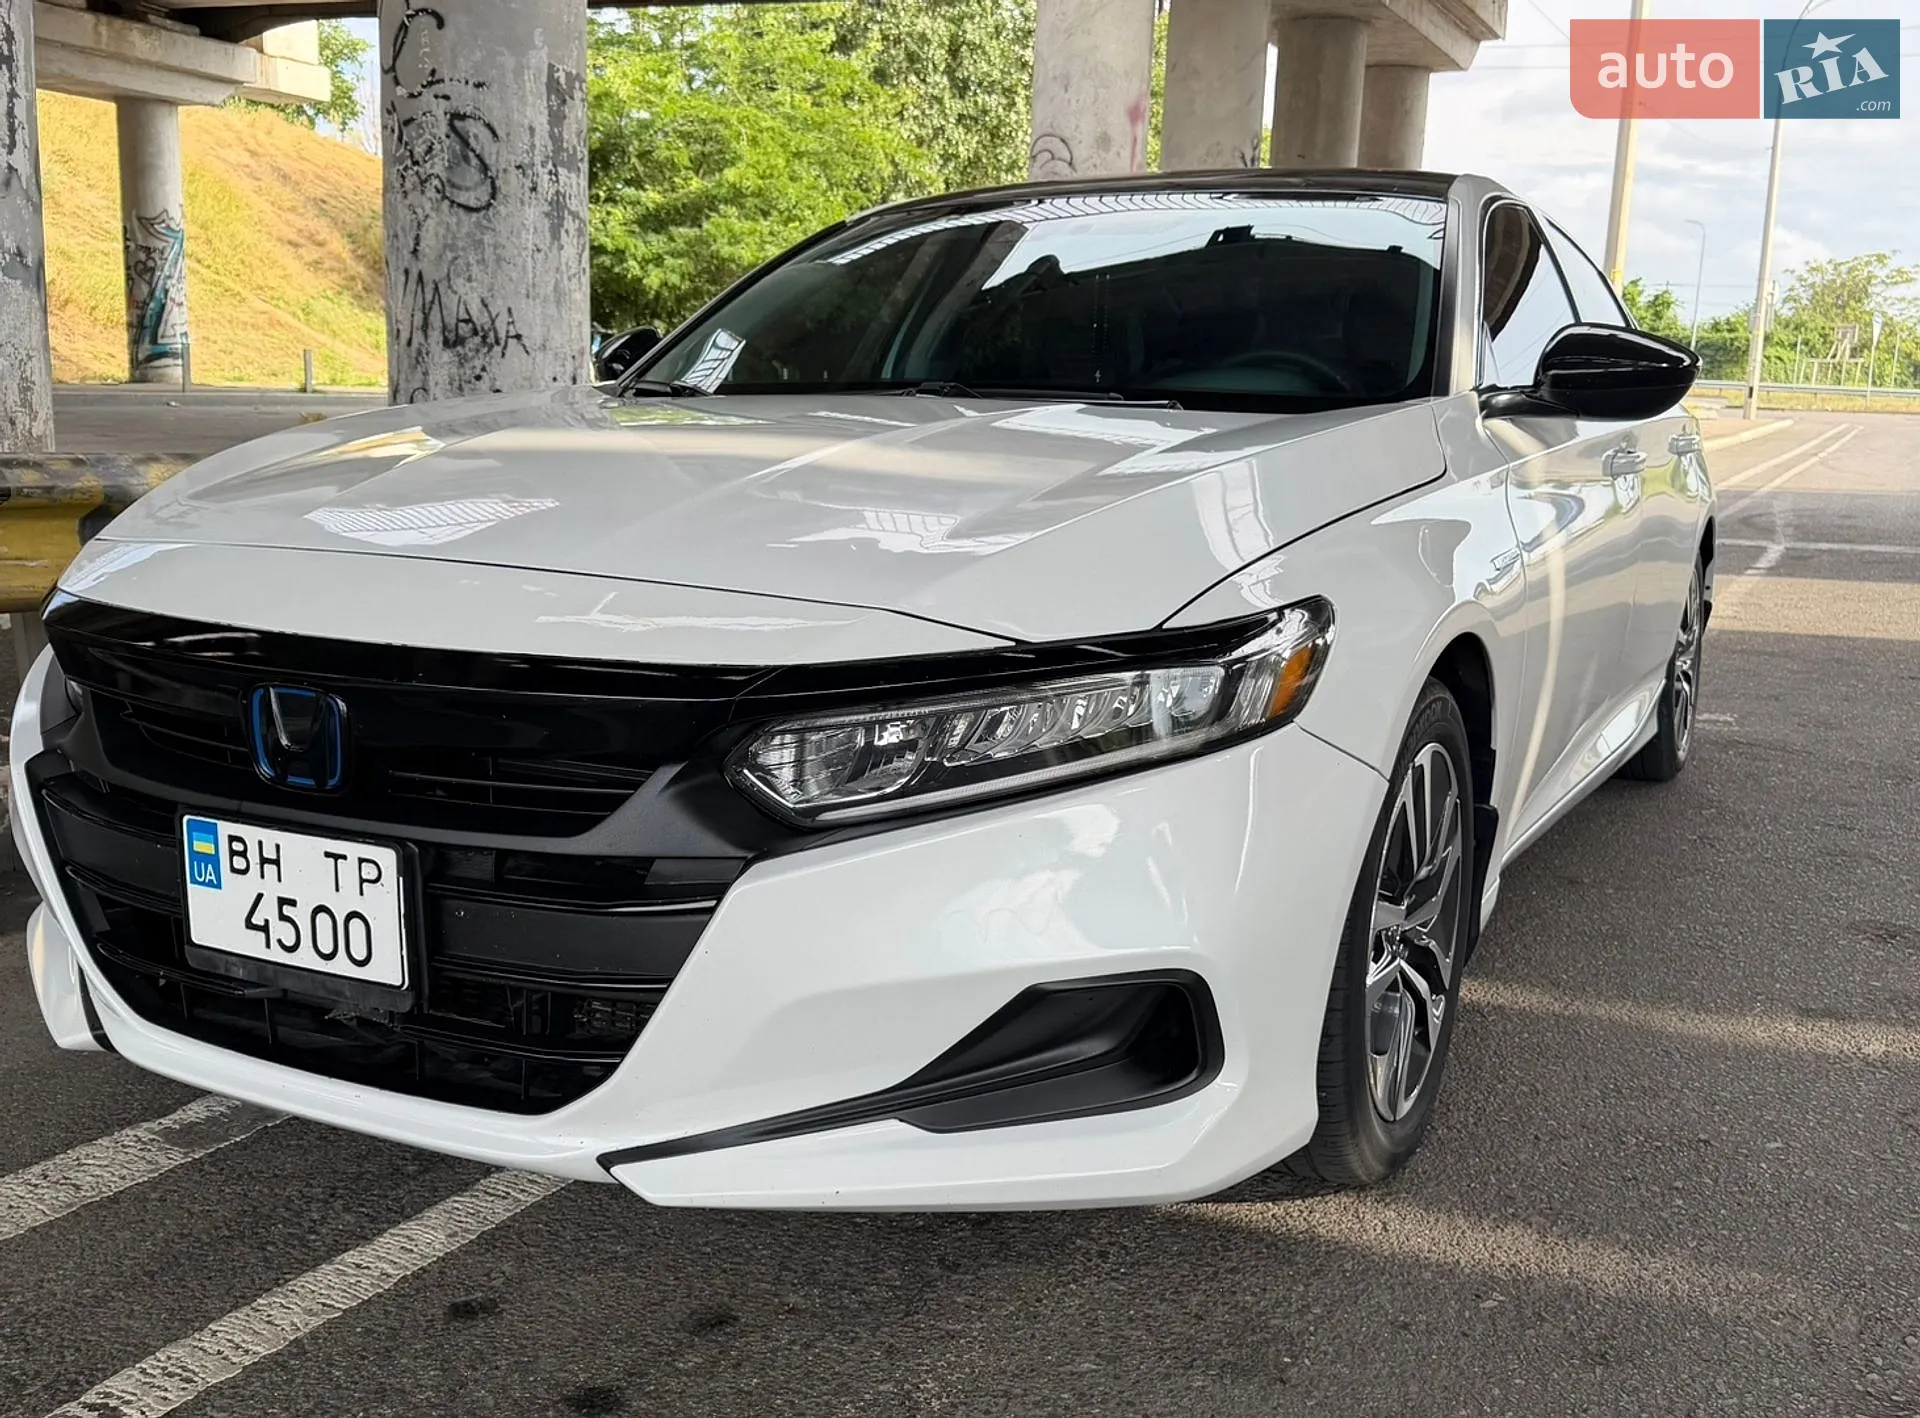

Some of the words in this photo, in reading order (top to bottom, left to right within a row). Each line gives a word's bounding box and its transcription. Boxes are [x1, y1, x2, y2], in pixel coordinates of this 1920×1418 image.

[193, 861, 218, 885] UA
[227, 834, 282, 883] BH
[323, 850, 383, 897] TP
[244, 892, 373, 968] 4500
